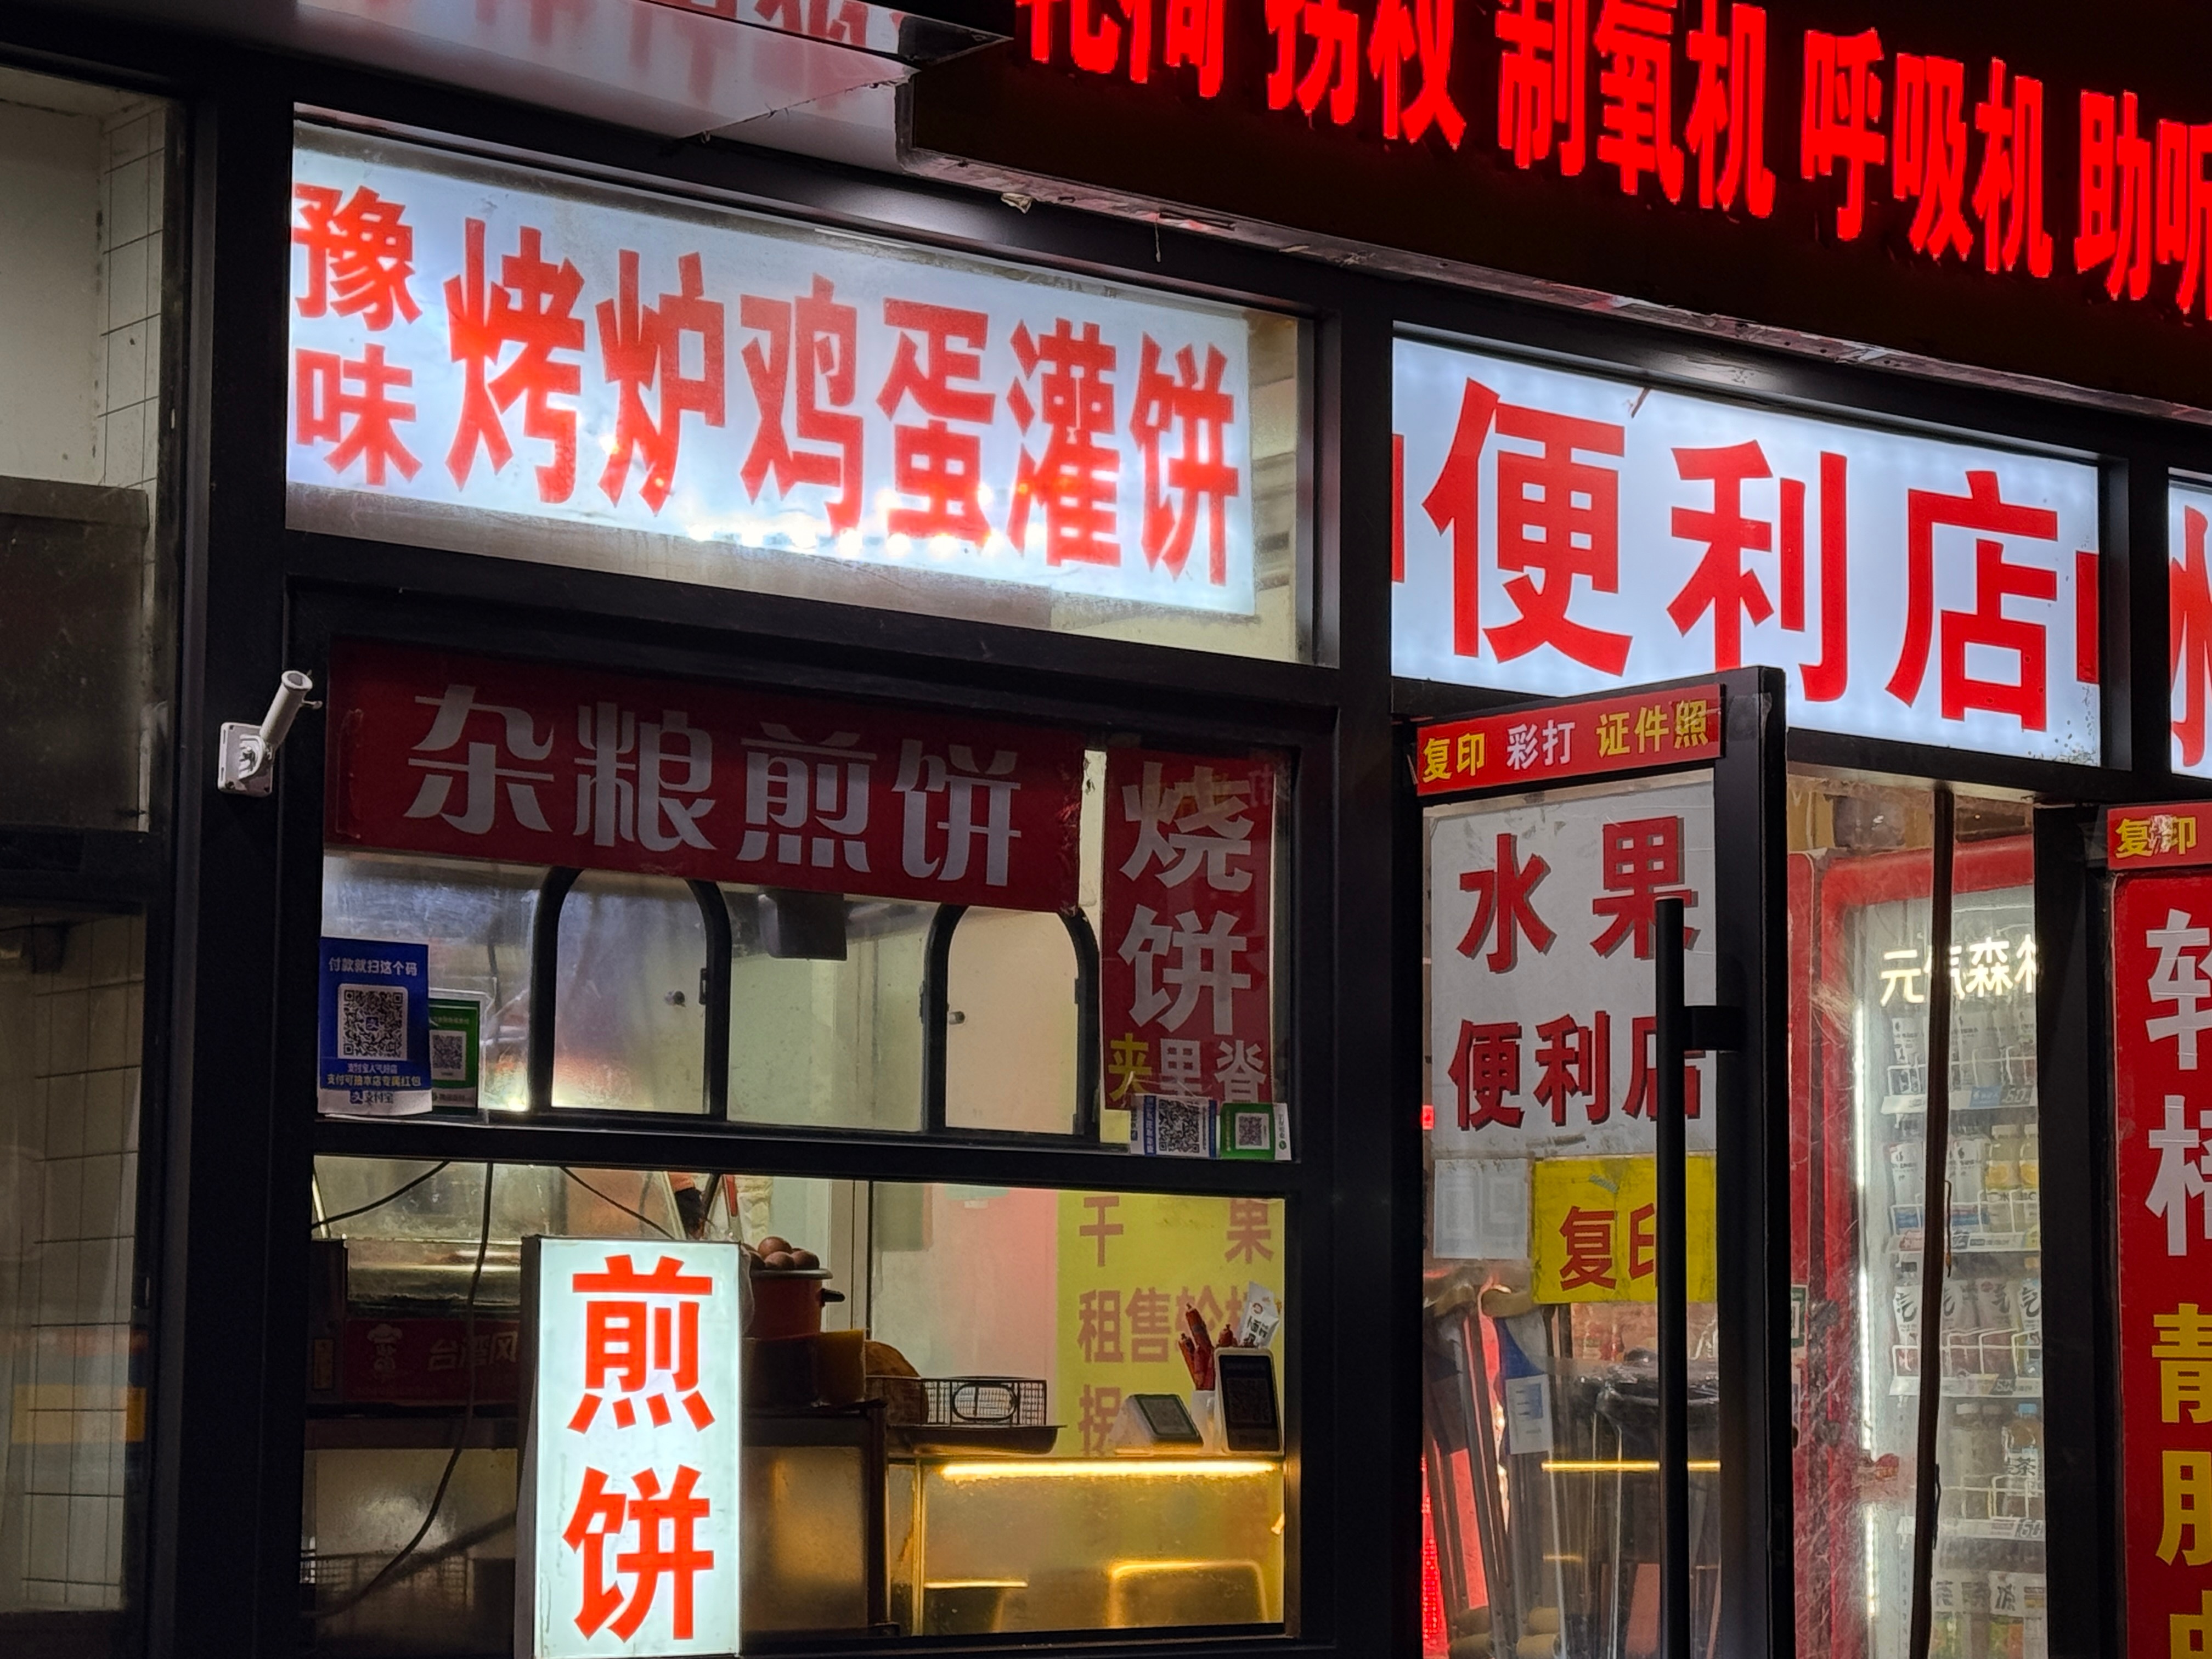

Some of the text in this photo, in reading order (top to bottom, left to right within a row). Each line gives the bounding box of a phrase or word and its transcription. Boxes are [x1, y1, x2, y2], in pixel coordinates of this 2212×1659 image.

[1495, 0, 1776, 218] 制氧机
[1799, 26, 2052, 279] 呼吸机
[2074, 88, 2212, 321] 助听
[443, 217, 1240, 587] 烤炉鸡蛋灌饼
[1421, 376, 2060, 732] 便利店
[402, 683, 1023, 888] 杂粮煎饼
[1422, 699, 1709, 783] 复印 彩打 证件照
[2115, 815, 2198, 860] 复印
[329, 957, 418, 977] 付款就扫这个码
[1118, 760, 1255, 1037] 烧饼
[1457, 815, 1702, 971] 水果
[1108, 1032, 1267, 1104] 夹里脊
[562, 1254, 715, 1644] 煎饼
